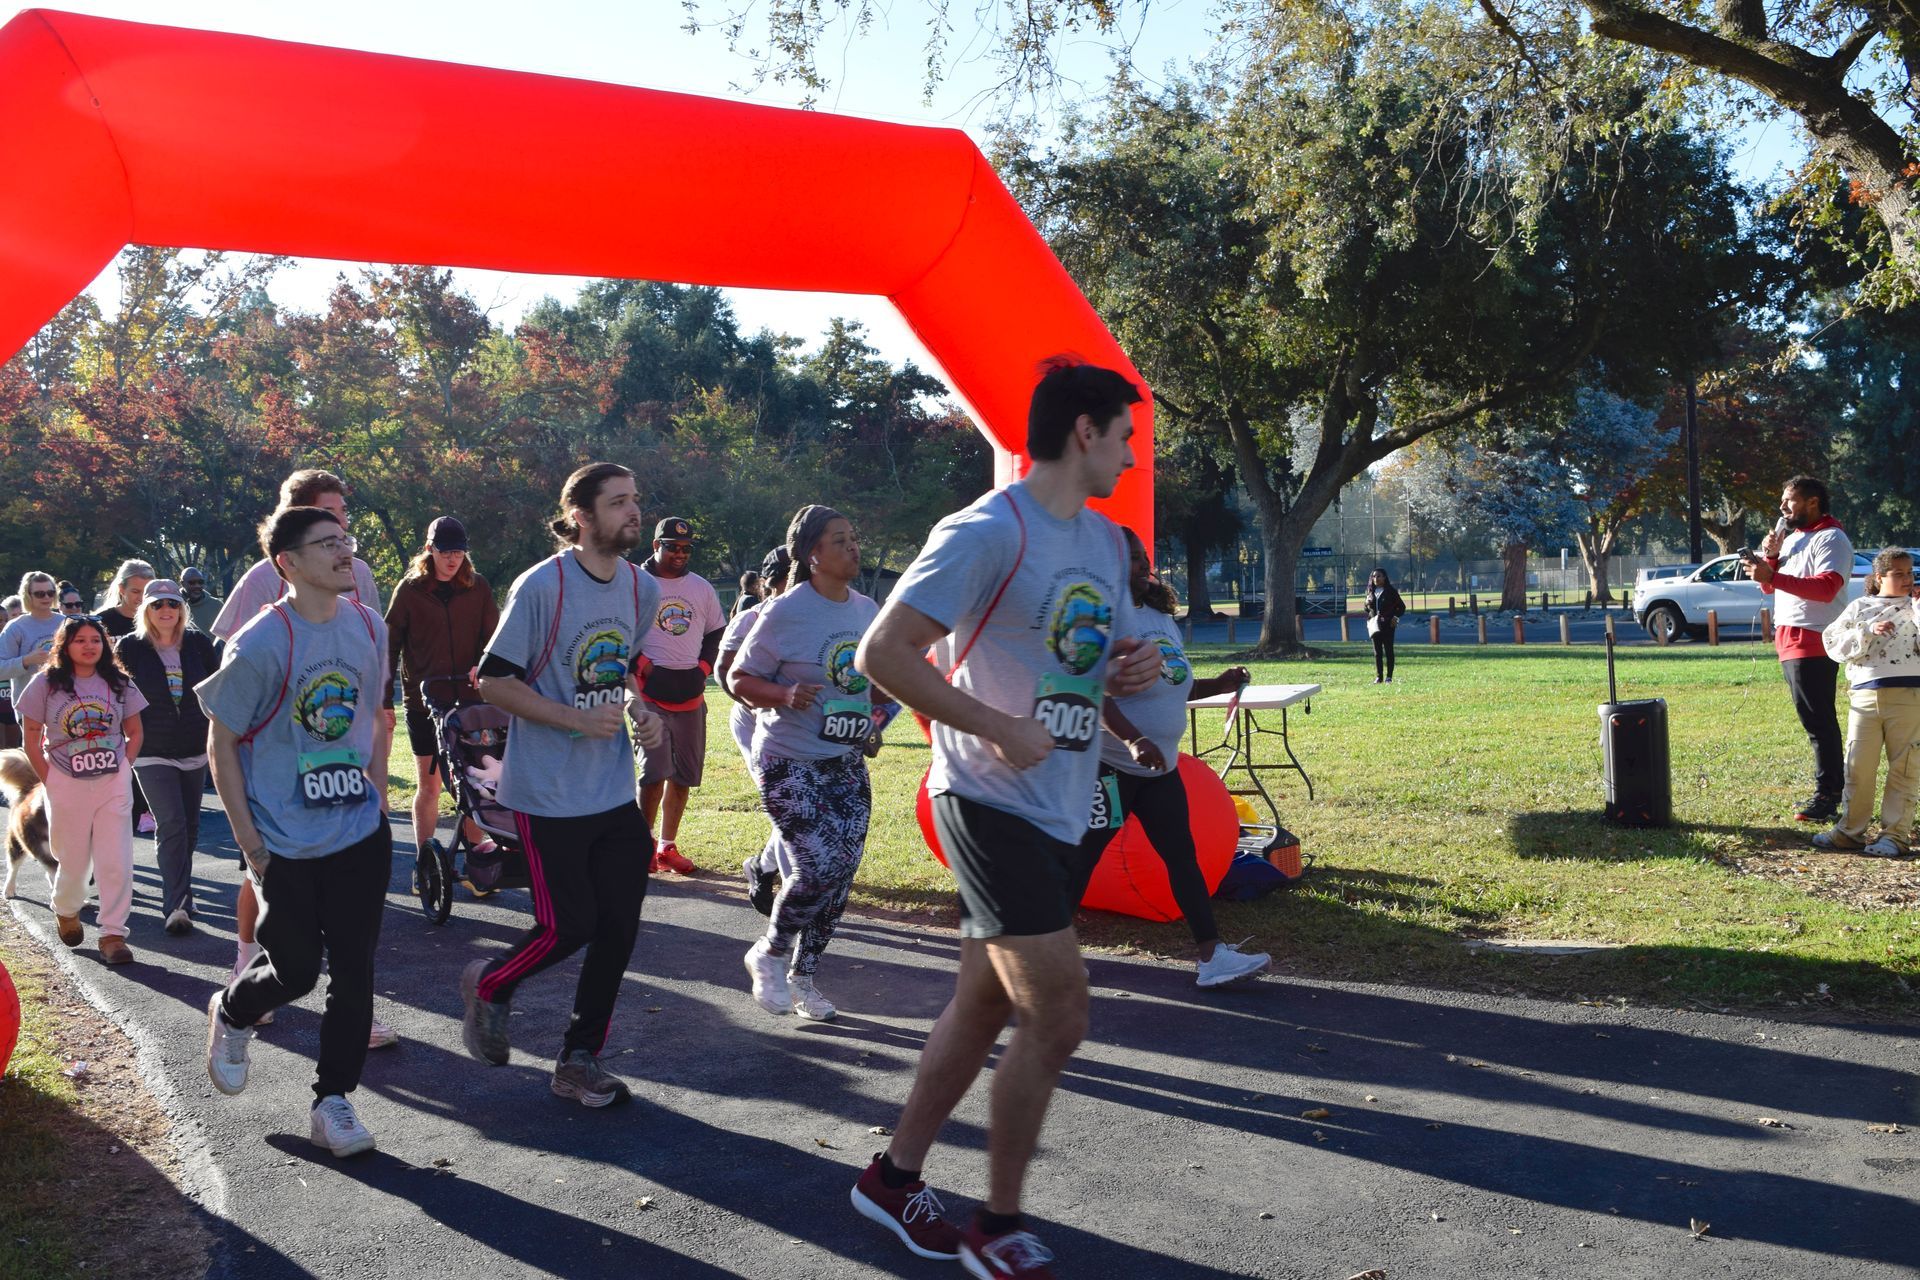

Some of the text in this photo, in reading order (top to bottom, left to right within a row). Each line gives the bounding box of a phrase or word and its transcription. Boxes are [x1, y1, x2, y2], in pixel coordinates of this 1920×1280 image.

[561, 631, 585, 667] Lamont
[584, 617, 613, 630] Meyers
[824, 716, 868, 738] 6012
[1034, 699, 1097, 741] 6003
[71, 751, 117, 772] 6032
[303, 768, 364, 800] 6008
